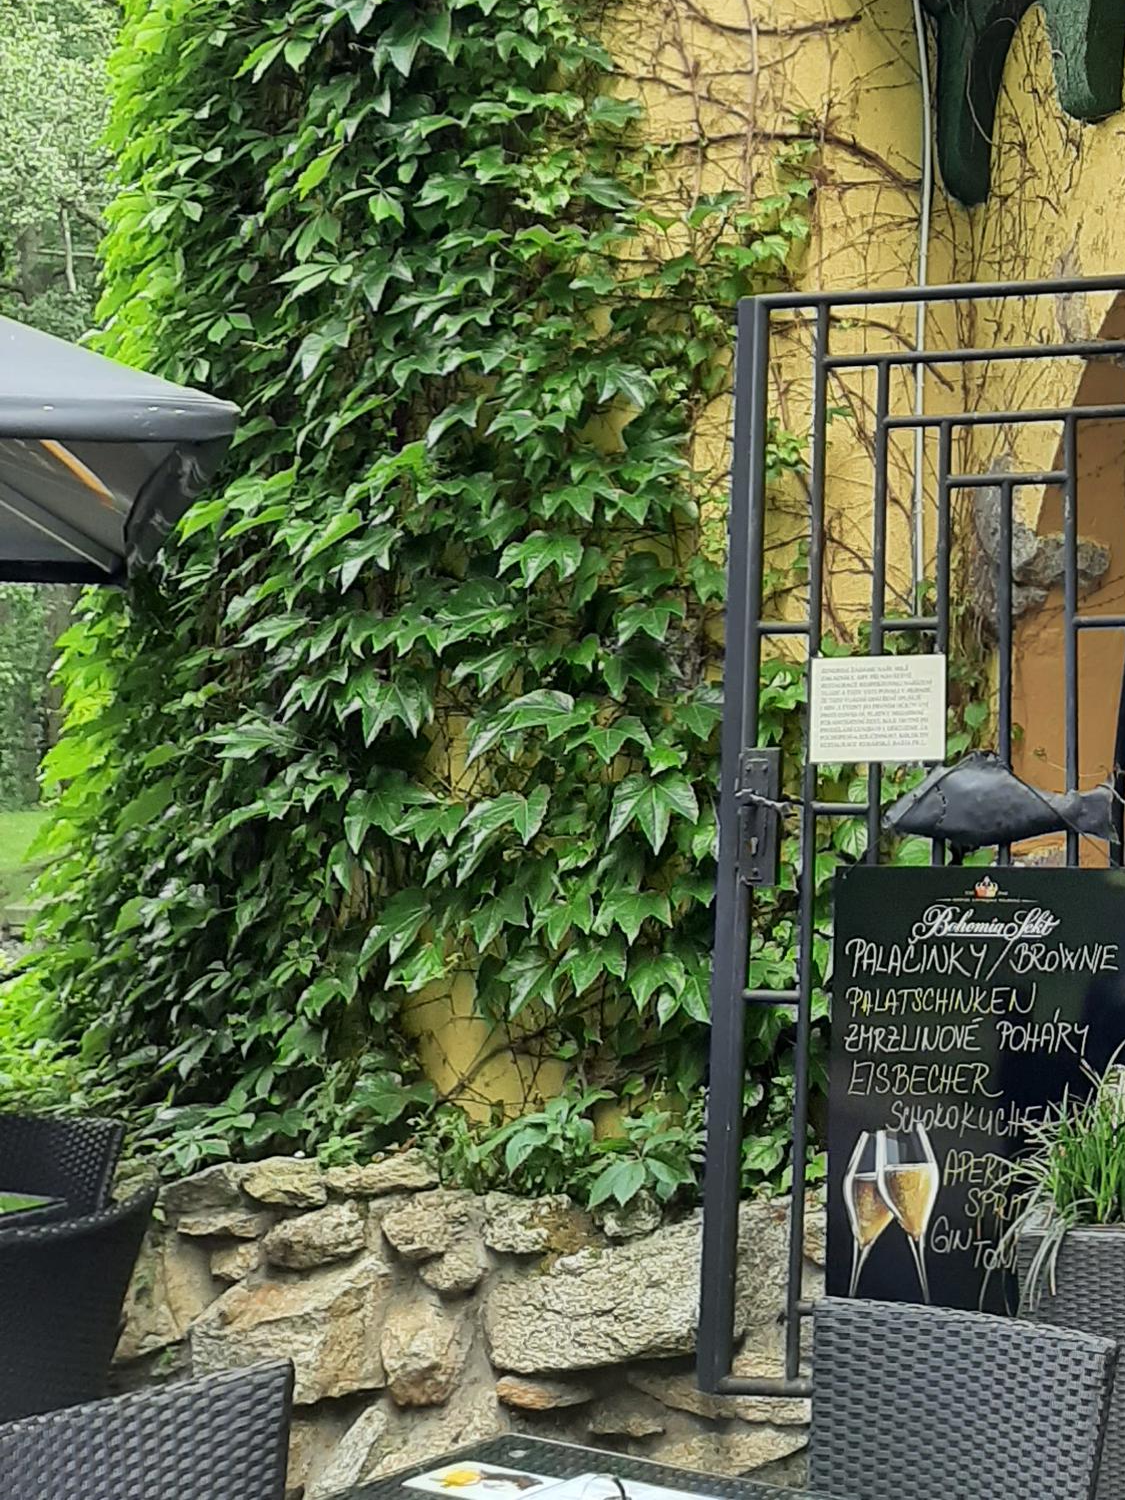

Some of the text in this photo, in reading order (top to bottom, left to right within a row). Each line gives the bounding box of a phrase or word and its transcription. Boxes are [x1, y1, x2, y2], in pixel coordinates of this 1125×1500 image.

[911, 904, 1061, 941] Bohemia Sekt
[845, 937, 988, 981] PALAČINKY
[1009, 942, 1120, 975] BROWNIE
[845, 982, 1038, 1018] PALATSCHINKEN
[844, 1008, 1090, 1057] ZMRZLINOVÉ POHÁRY
[847, 1060, 1004, 1098] EISBECHER
[931, 1215, 973, 1254] GIN
